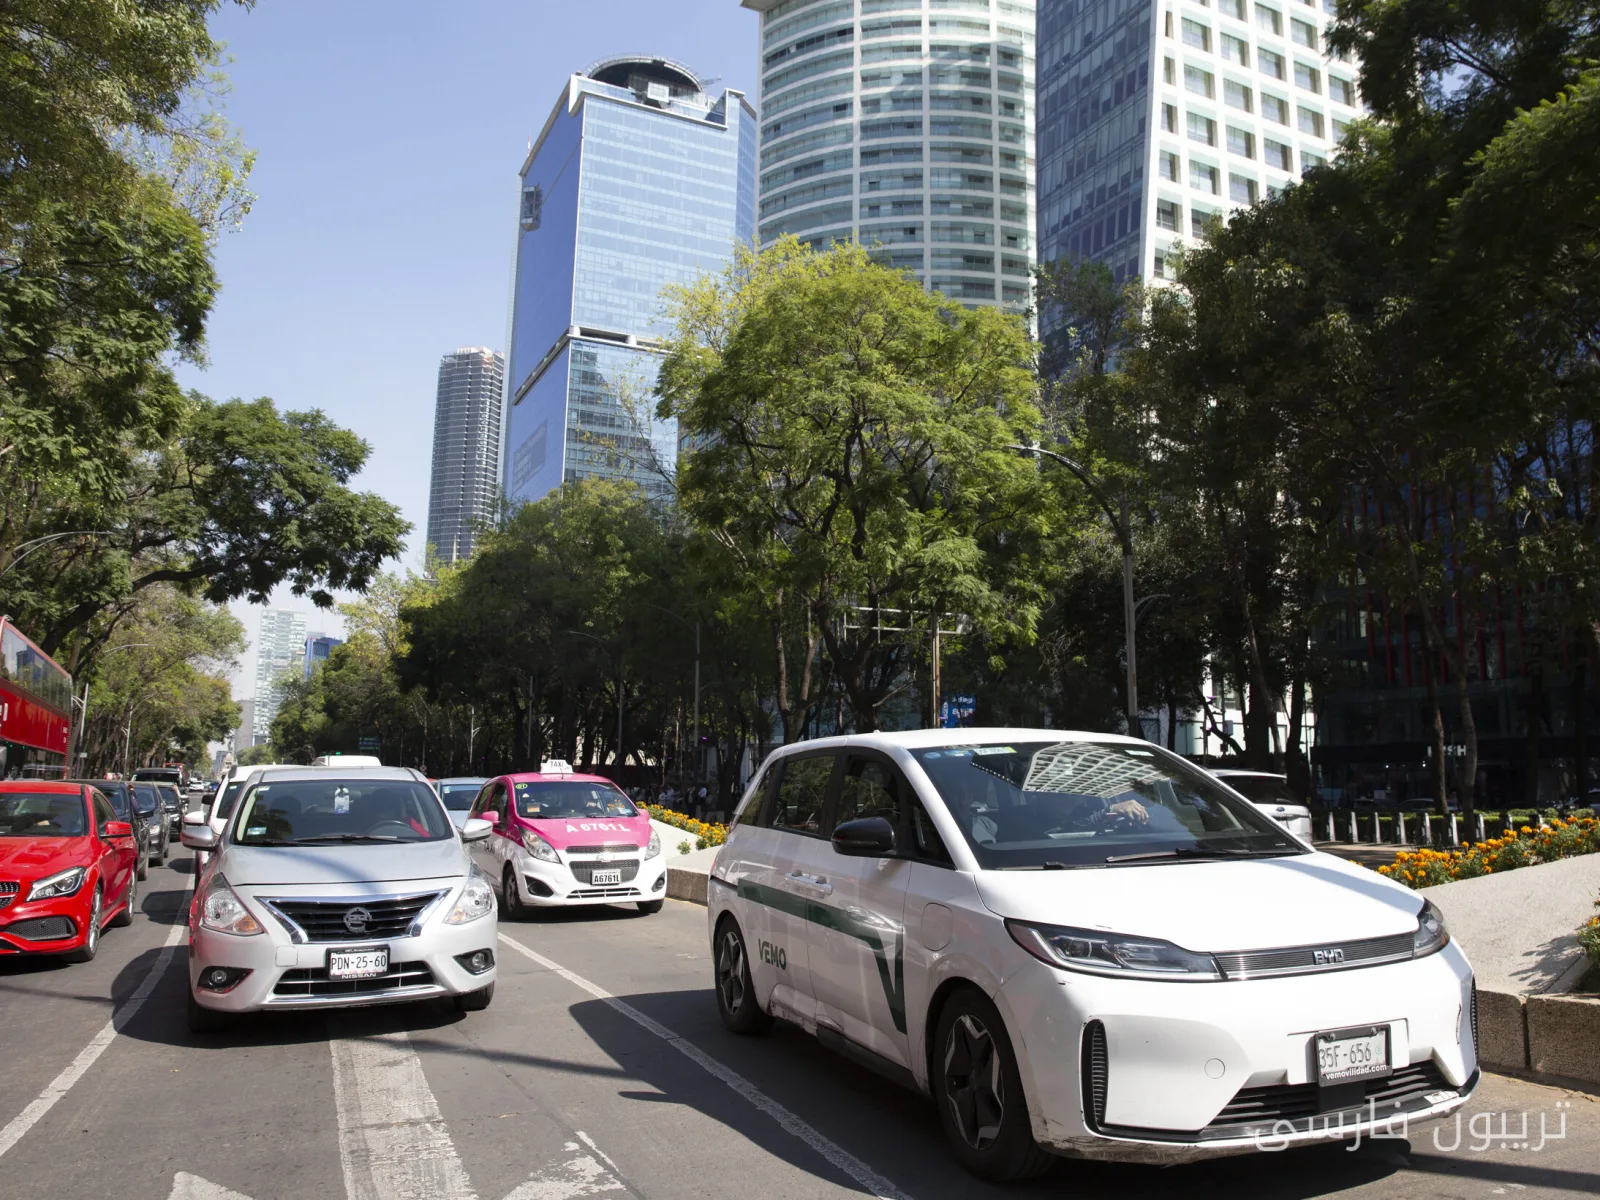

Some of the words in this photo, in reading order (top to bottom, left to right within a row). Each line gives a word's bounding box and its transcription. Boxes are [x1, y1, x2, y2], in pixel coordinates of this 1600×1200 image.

[594, 875, 619, 883] A6761L
[758, 938, 787, 970] VEMO
[1313, 949, 1344, 964] BYD
[331, 955, 387, 970] PDN-25-60
[341, 972, 377, 980] NISSAN
[1325, 1063, 1387, 1080] vemovilidad.com
